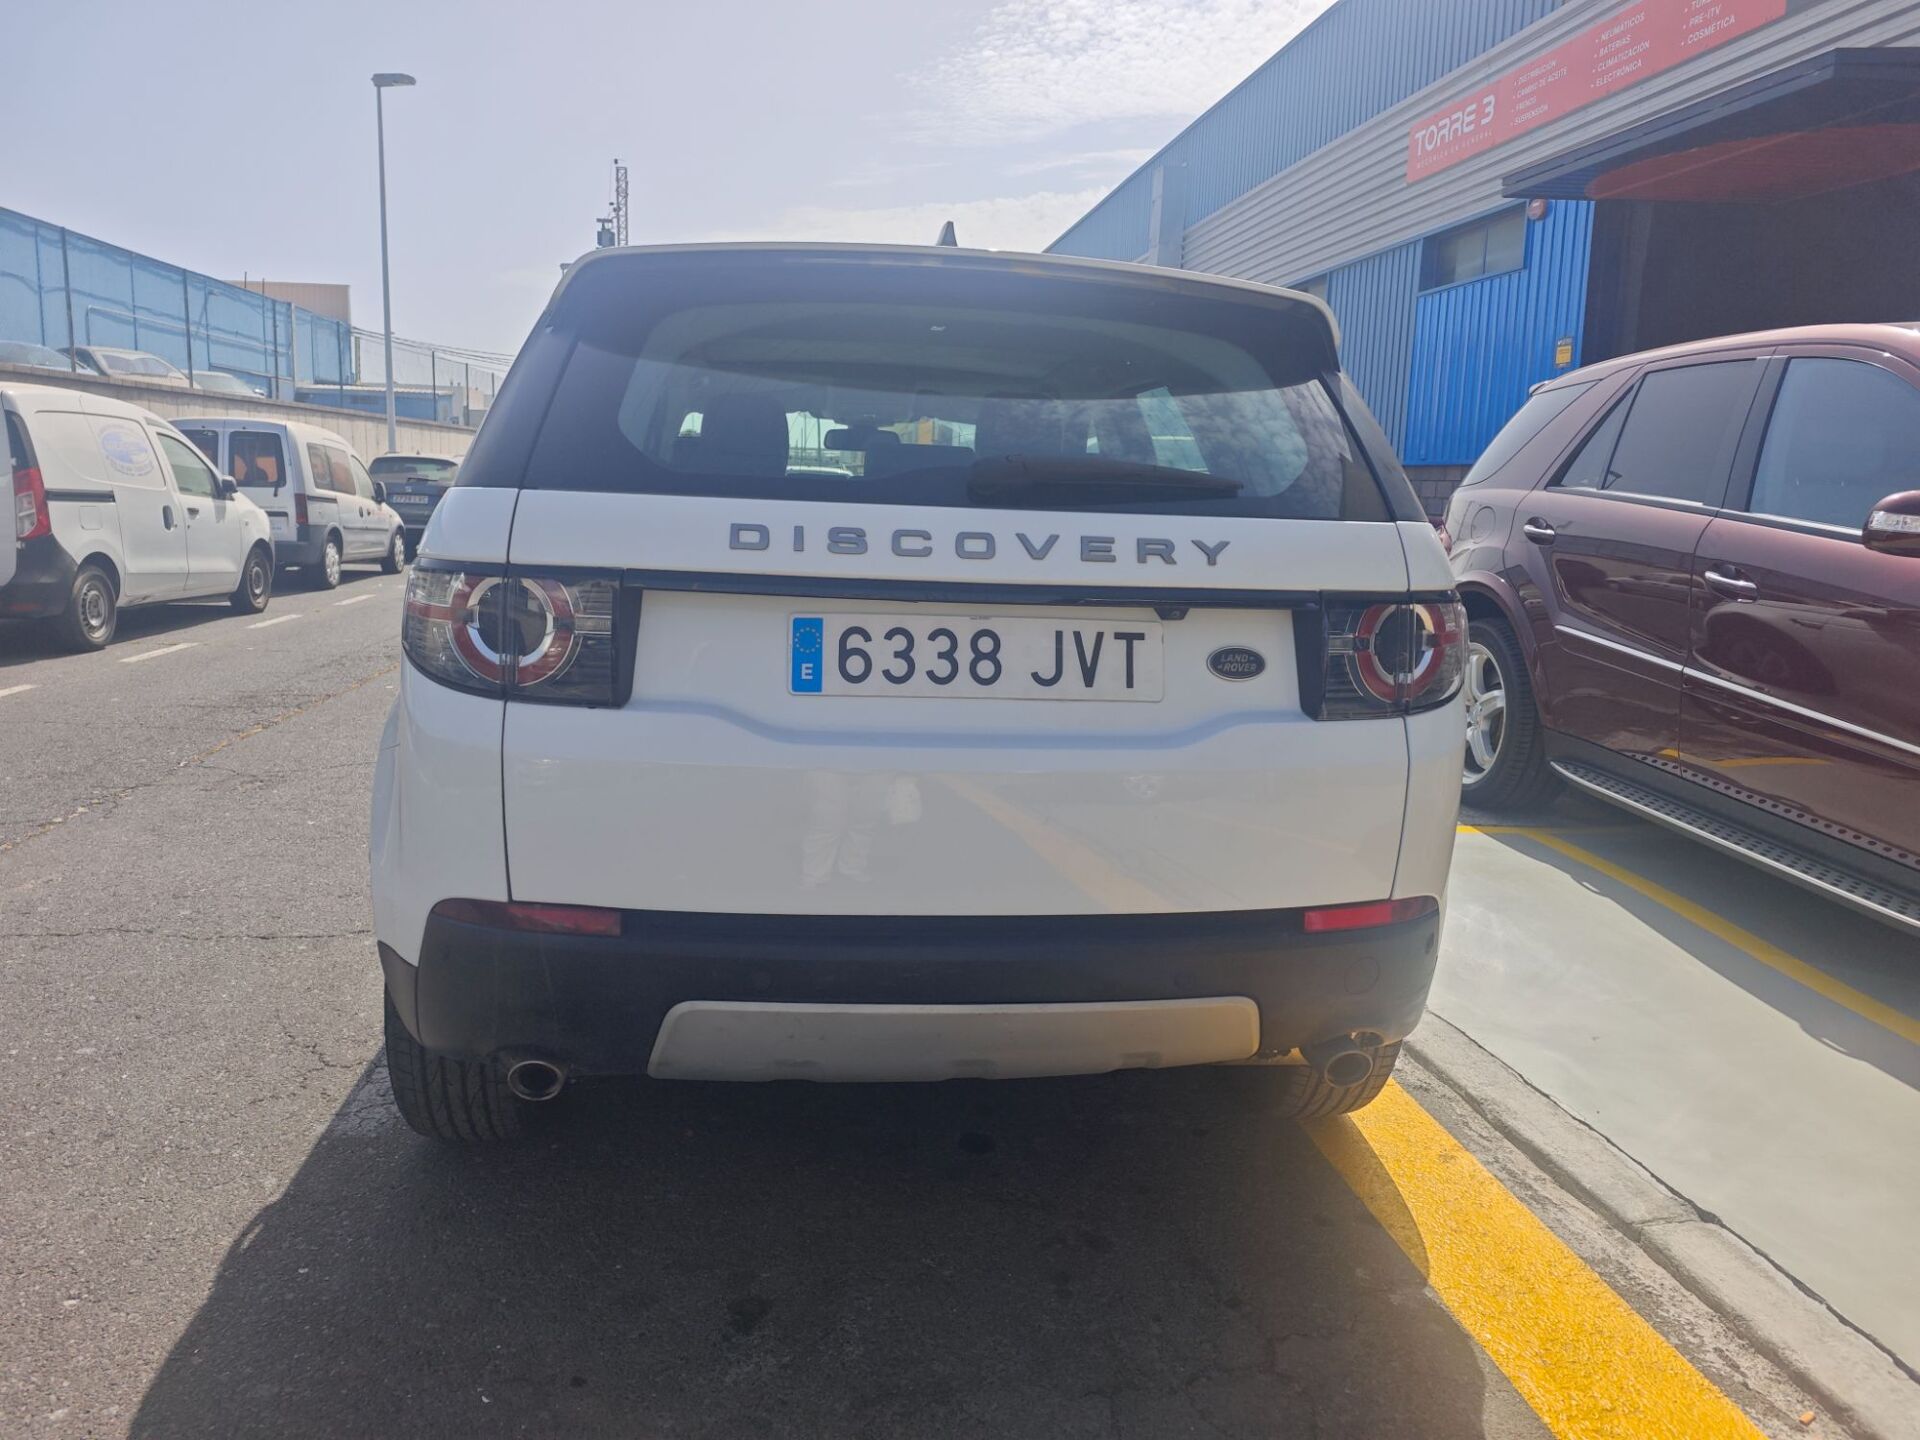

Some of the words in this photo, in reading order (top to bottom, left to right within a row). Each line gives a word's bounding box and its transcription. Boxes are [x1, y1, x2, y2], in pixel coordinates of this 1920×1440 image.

[1415, 104, 1477, 155] TORRE
[1481, 95, 1496, 125] 3
[729, 523, 1231, 566] DISCOVERY
[801, 663, 813, 680] E
[838, 626, 1001, 686] 6338
[1030, 630, 1145, 689] JVT
